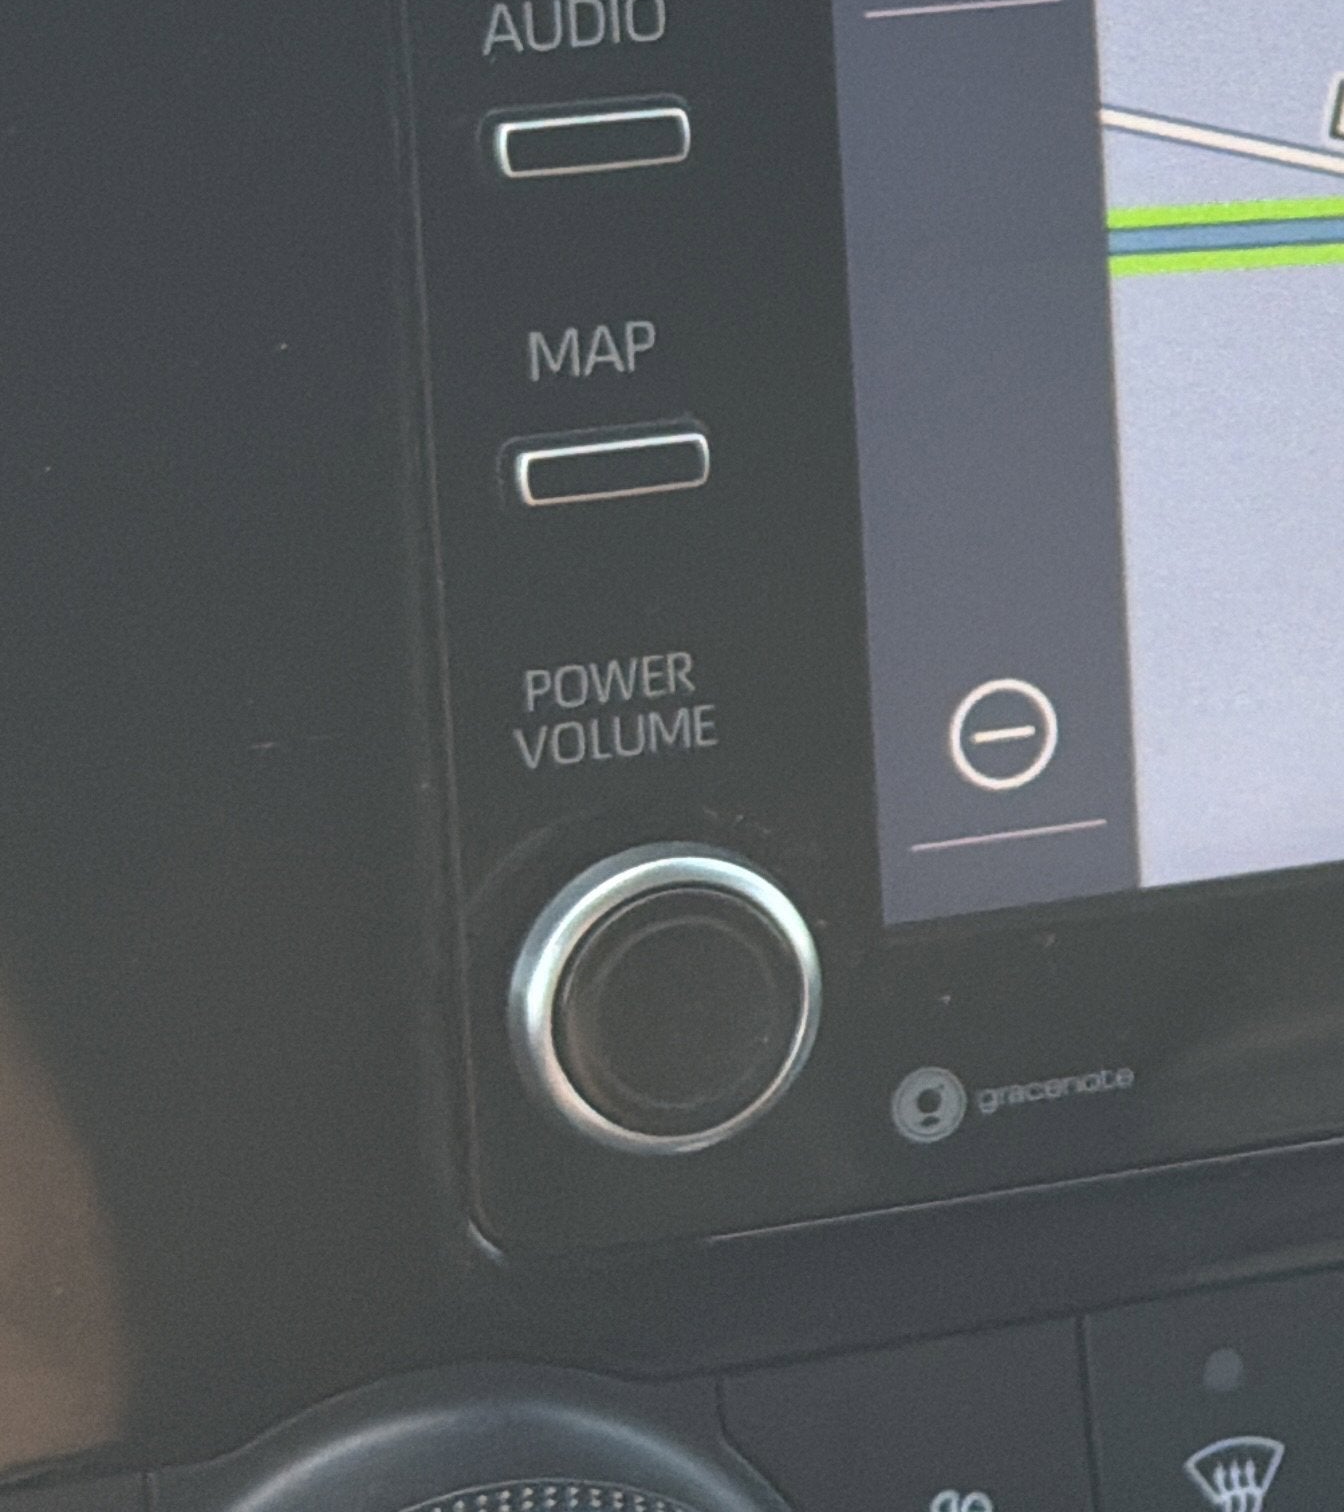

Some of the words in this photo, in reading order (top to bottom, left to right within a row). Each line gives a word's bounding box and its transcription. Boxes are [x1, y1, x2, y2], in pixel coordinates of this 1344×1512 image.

[528, 320, 656, 381] MAP
[524, 651, 695, 712] POWER
[514, 704, 718, 770] VOLUME
[979, 1067, 1135, 1115] gracenote
